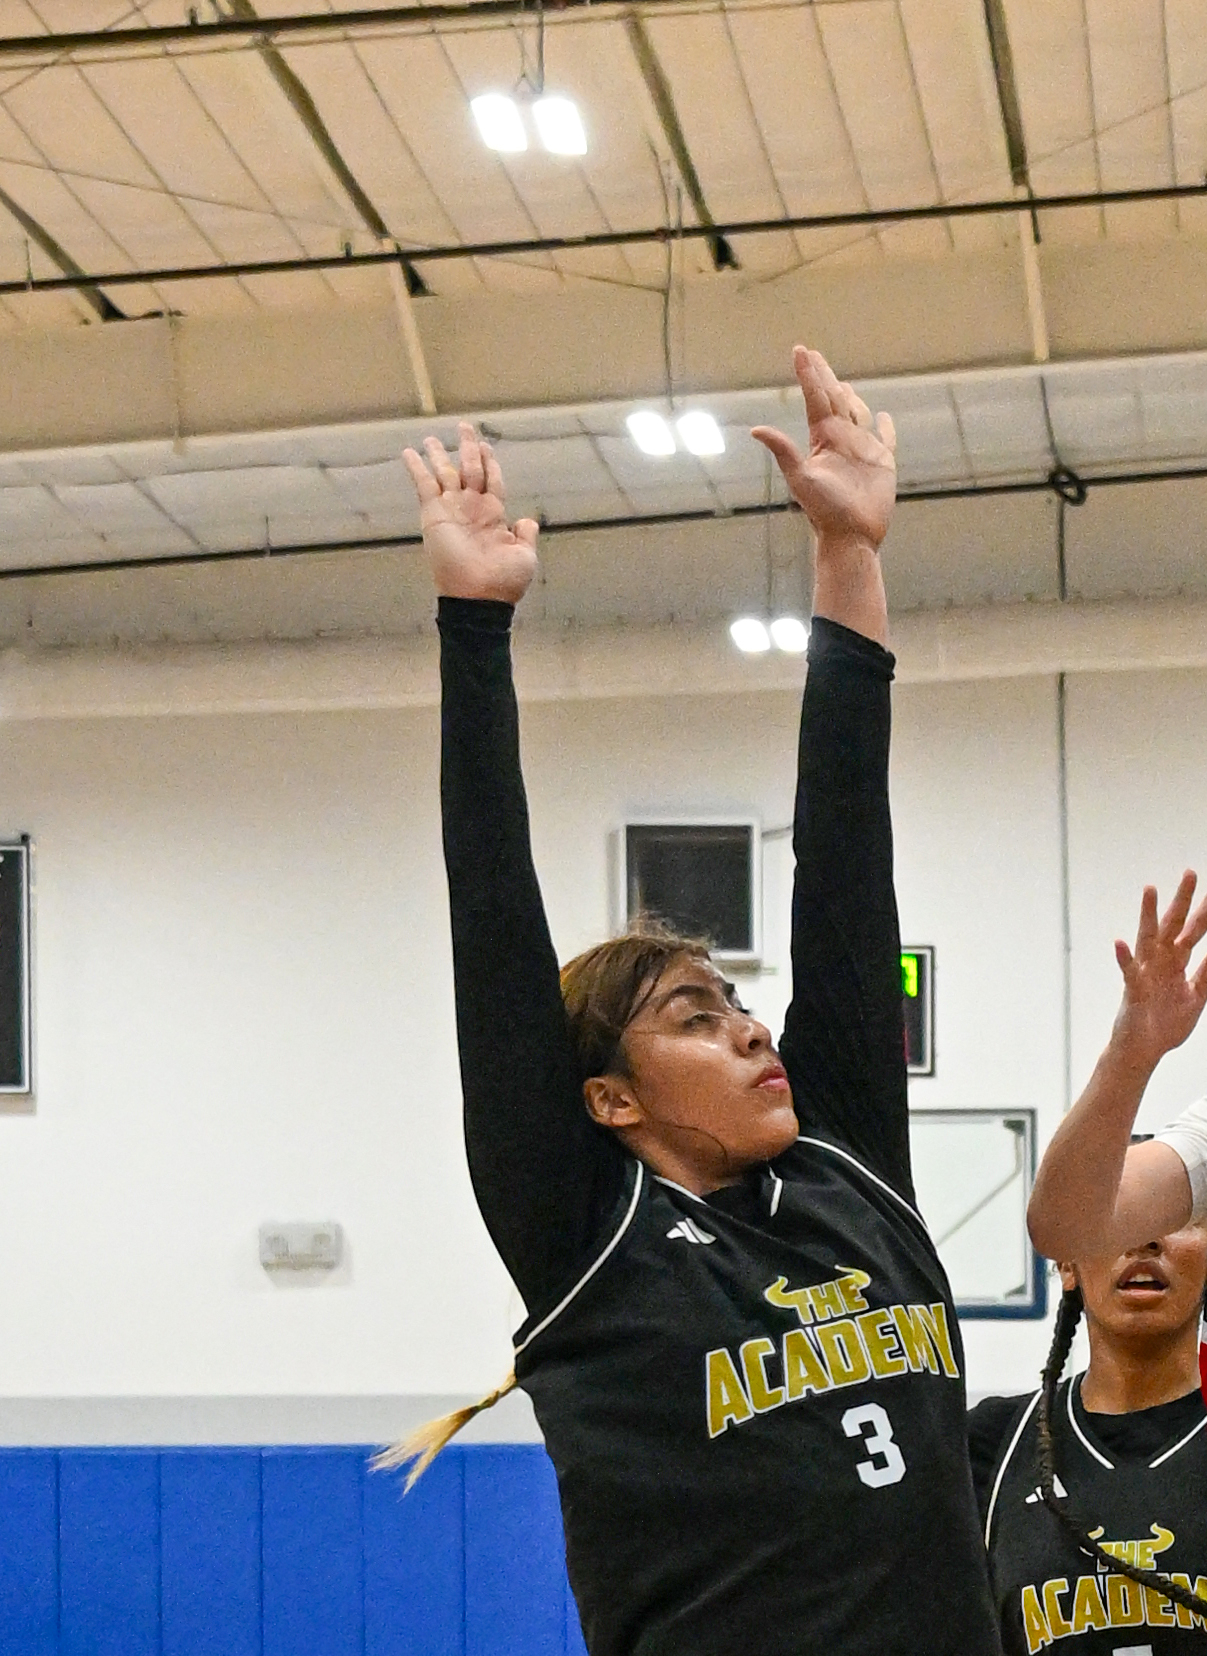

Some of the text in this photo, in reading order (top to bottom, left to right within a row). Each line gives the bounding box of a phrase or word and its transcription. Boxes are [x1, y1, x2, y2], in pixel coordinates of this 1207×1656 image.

[780, 1271, 870, 1325] THE
[706, 1302, 960, 1439] ACADEMY
[841, 1403, 907, 1489] 3
